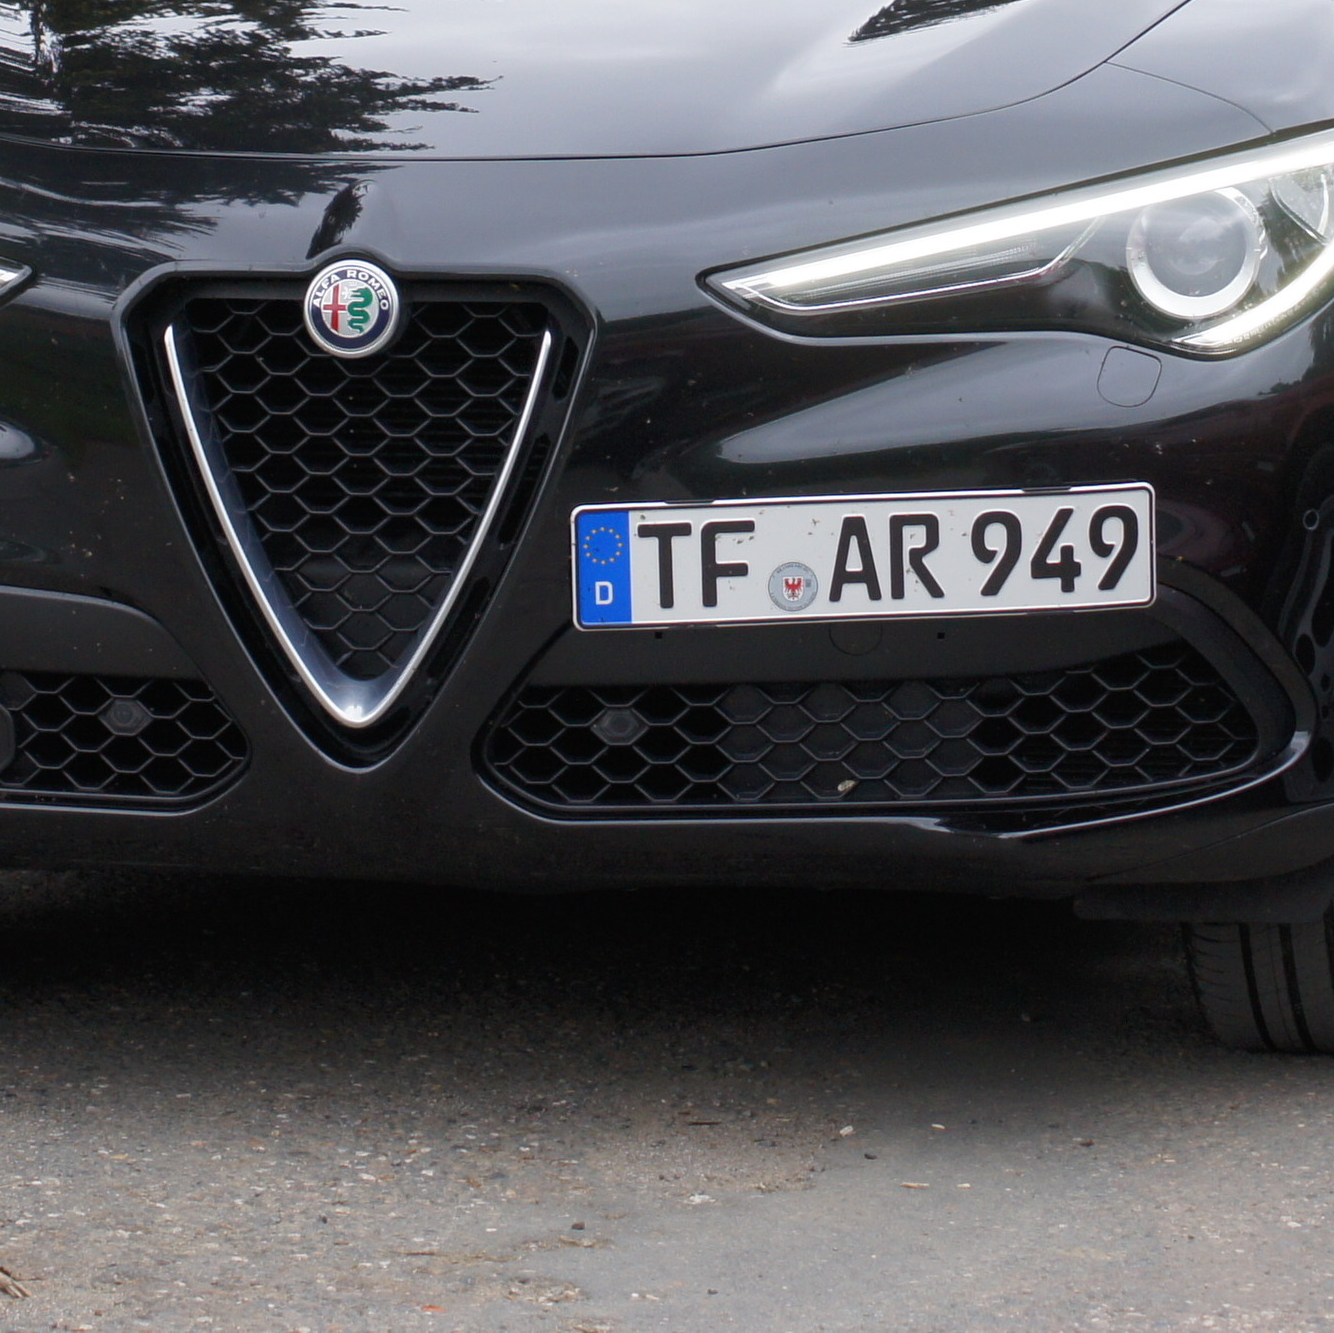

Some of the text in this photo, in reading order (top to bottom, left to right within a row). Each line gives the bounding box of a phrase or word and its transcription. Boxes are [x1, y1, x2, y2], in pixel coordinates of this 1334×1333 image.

[313, 270, 389, 310] ALFA ROMEO
[637, 519, 756, 609] TF
[828, 512, 945, 602] AR
[970, 504, 1139, 596] 949
[595, 580, 614, 605] D
